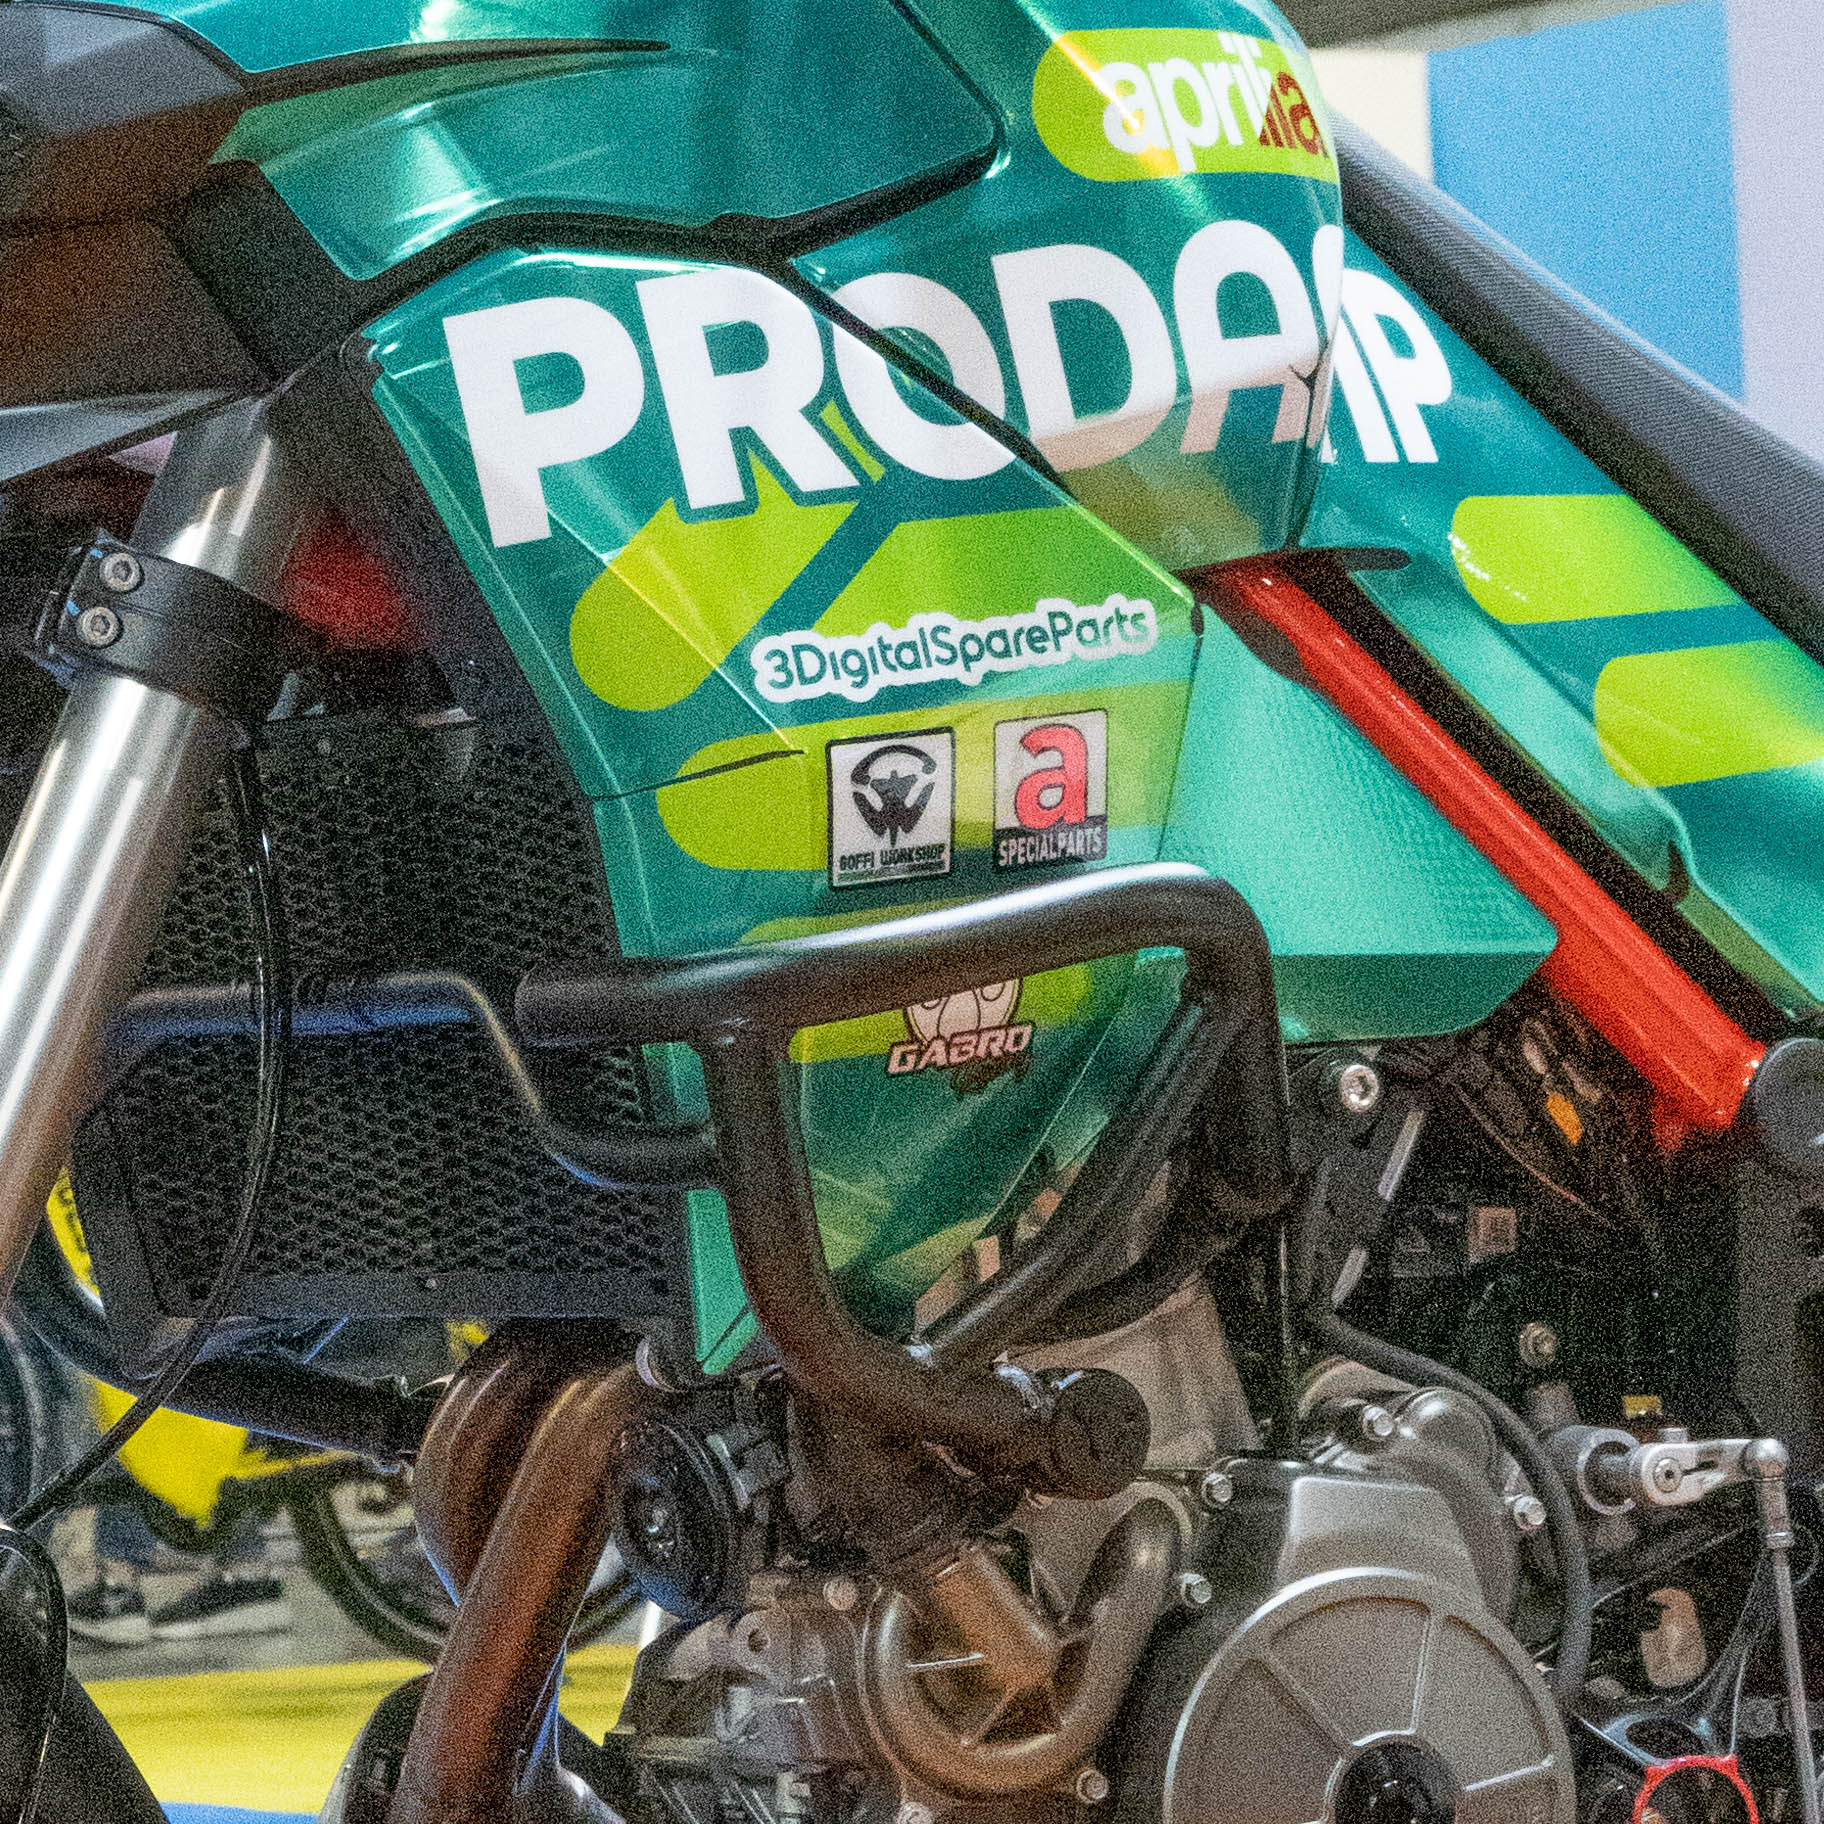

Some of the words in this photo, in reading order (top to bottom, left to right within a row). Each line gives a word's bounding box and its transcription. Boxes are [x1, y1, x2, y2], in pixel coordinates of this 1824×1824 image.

[1102, 31, 1330, 174] aprilia
[1013, 723, 1088, 830] a
[886, 1022, 1034, 1076] GABRO
